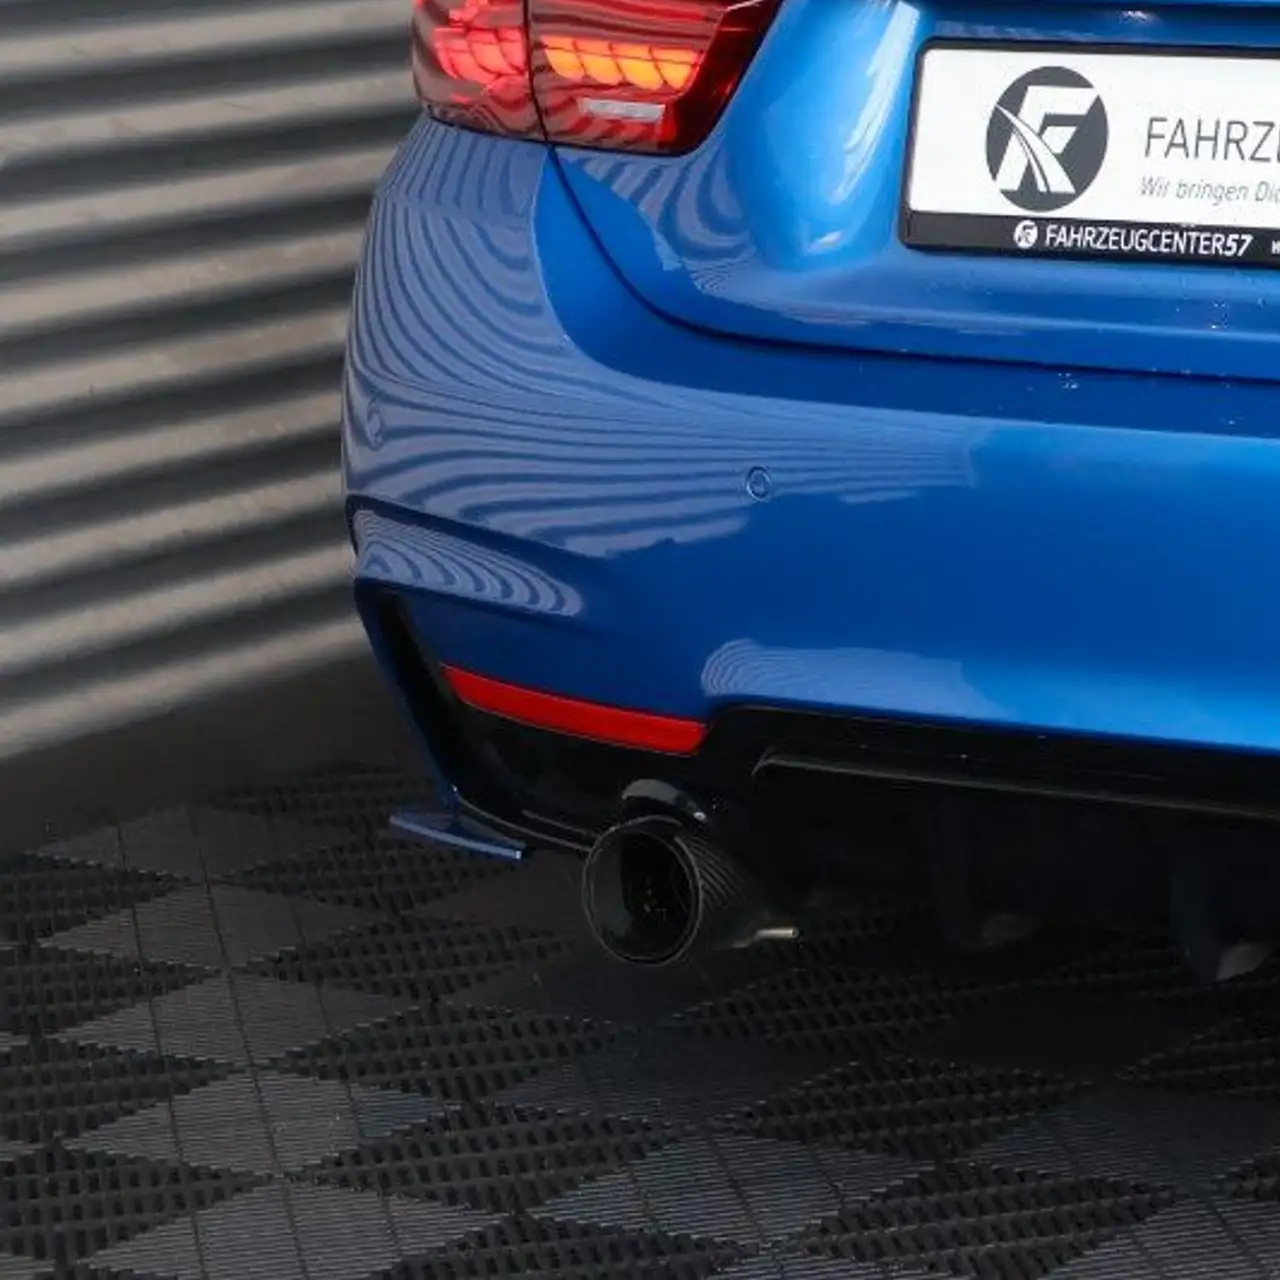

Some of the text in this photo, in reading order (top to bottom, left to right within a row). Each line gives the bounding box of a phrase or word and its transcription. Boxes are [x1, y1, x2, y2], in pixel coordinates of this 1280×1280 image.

[1139, 175, 1170, 199] Wir
[1175, 179, 1249, 207] bringen
[1044, 222, 1254, 258] FAHRZEUGCENTER57
